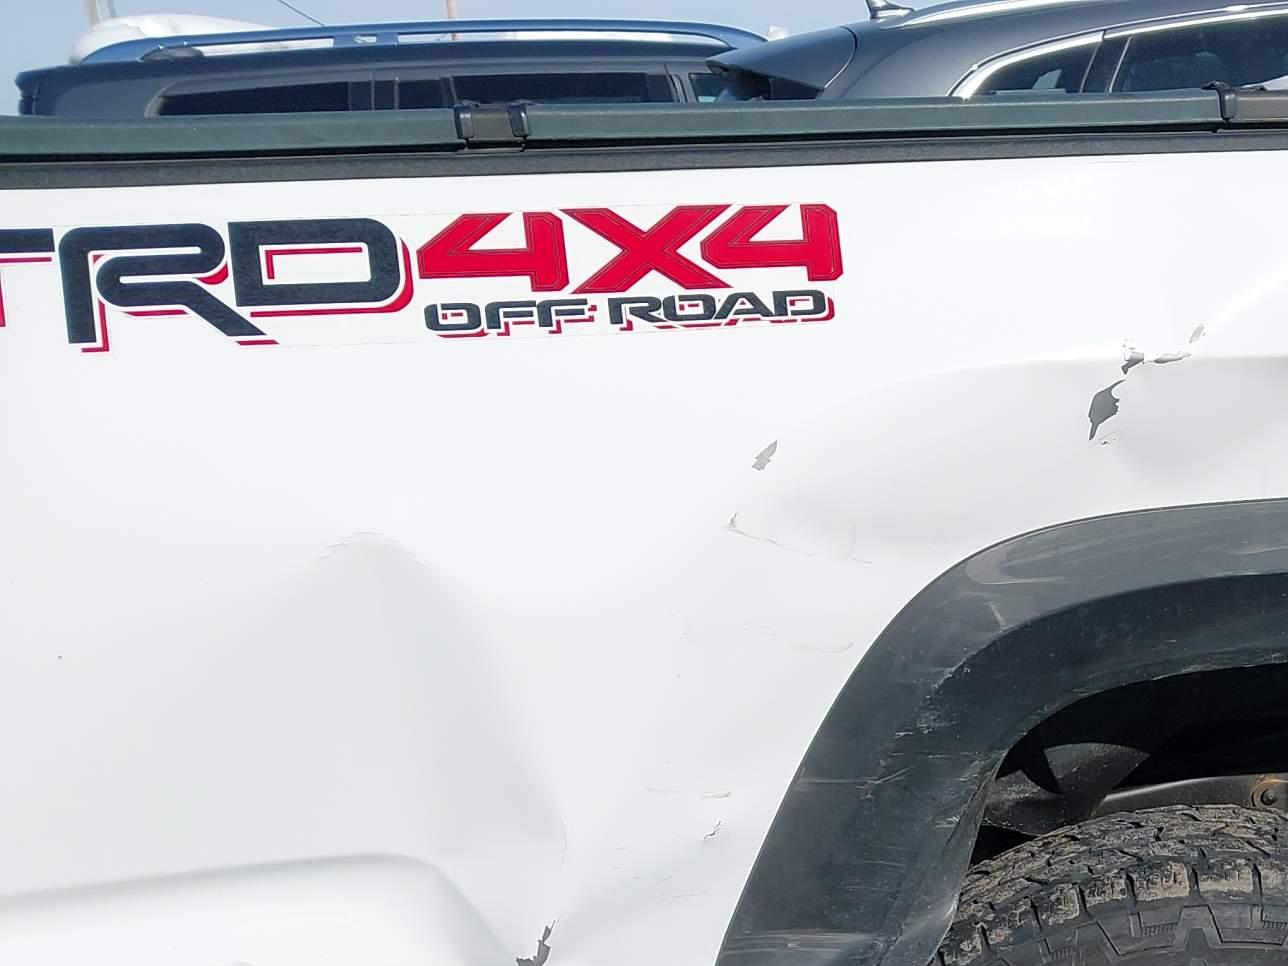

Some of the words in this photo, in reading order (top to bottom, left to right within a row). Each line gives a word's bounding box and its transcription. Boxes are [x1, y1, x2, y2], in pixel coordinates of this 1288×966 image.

[416, 203, 843, 294] 4X4
[424, 297, 596, 337] OFF
[607, 290, 835, 331] ROAD
